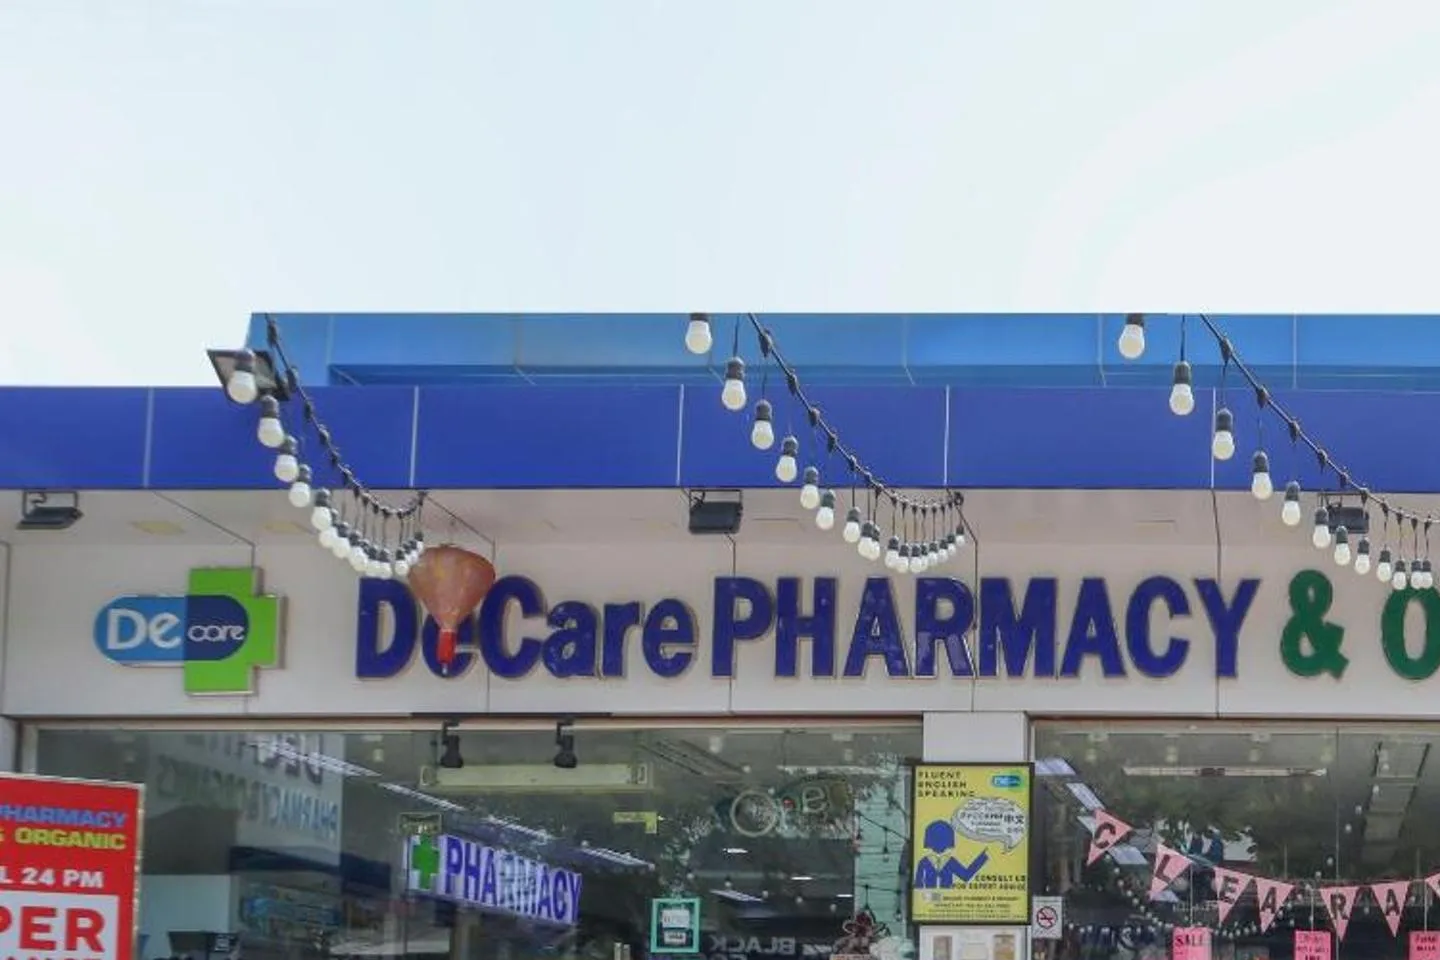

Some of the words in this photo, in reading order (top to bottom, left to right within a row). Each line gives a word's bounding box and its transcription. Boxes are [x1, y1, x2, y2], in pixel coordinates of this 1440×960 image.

[107, 608, 182, 650] De
[711, 575, 1261, 679] PHARMACY
[1280, 569, 1350, 680] &
[15, 827, 126, 850] ORGANIC
[20, 867, 56, 886] 24
[63, 869, 104, 889] PM
[444, 836, 583, 923] PHARMACY
